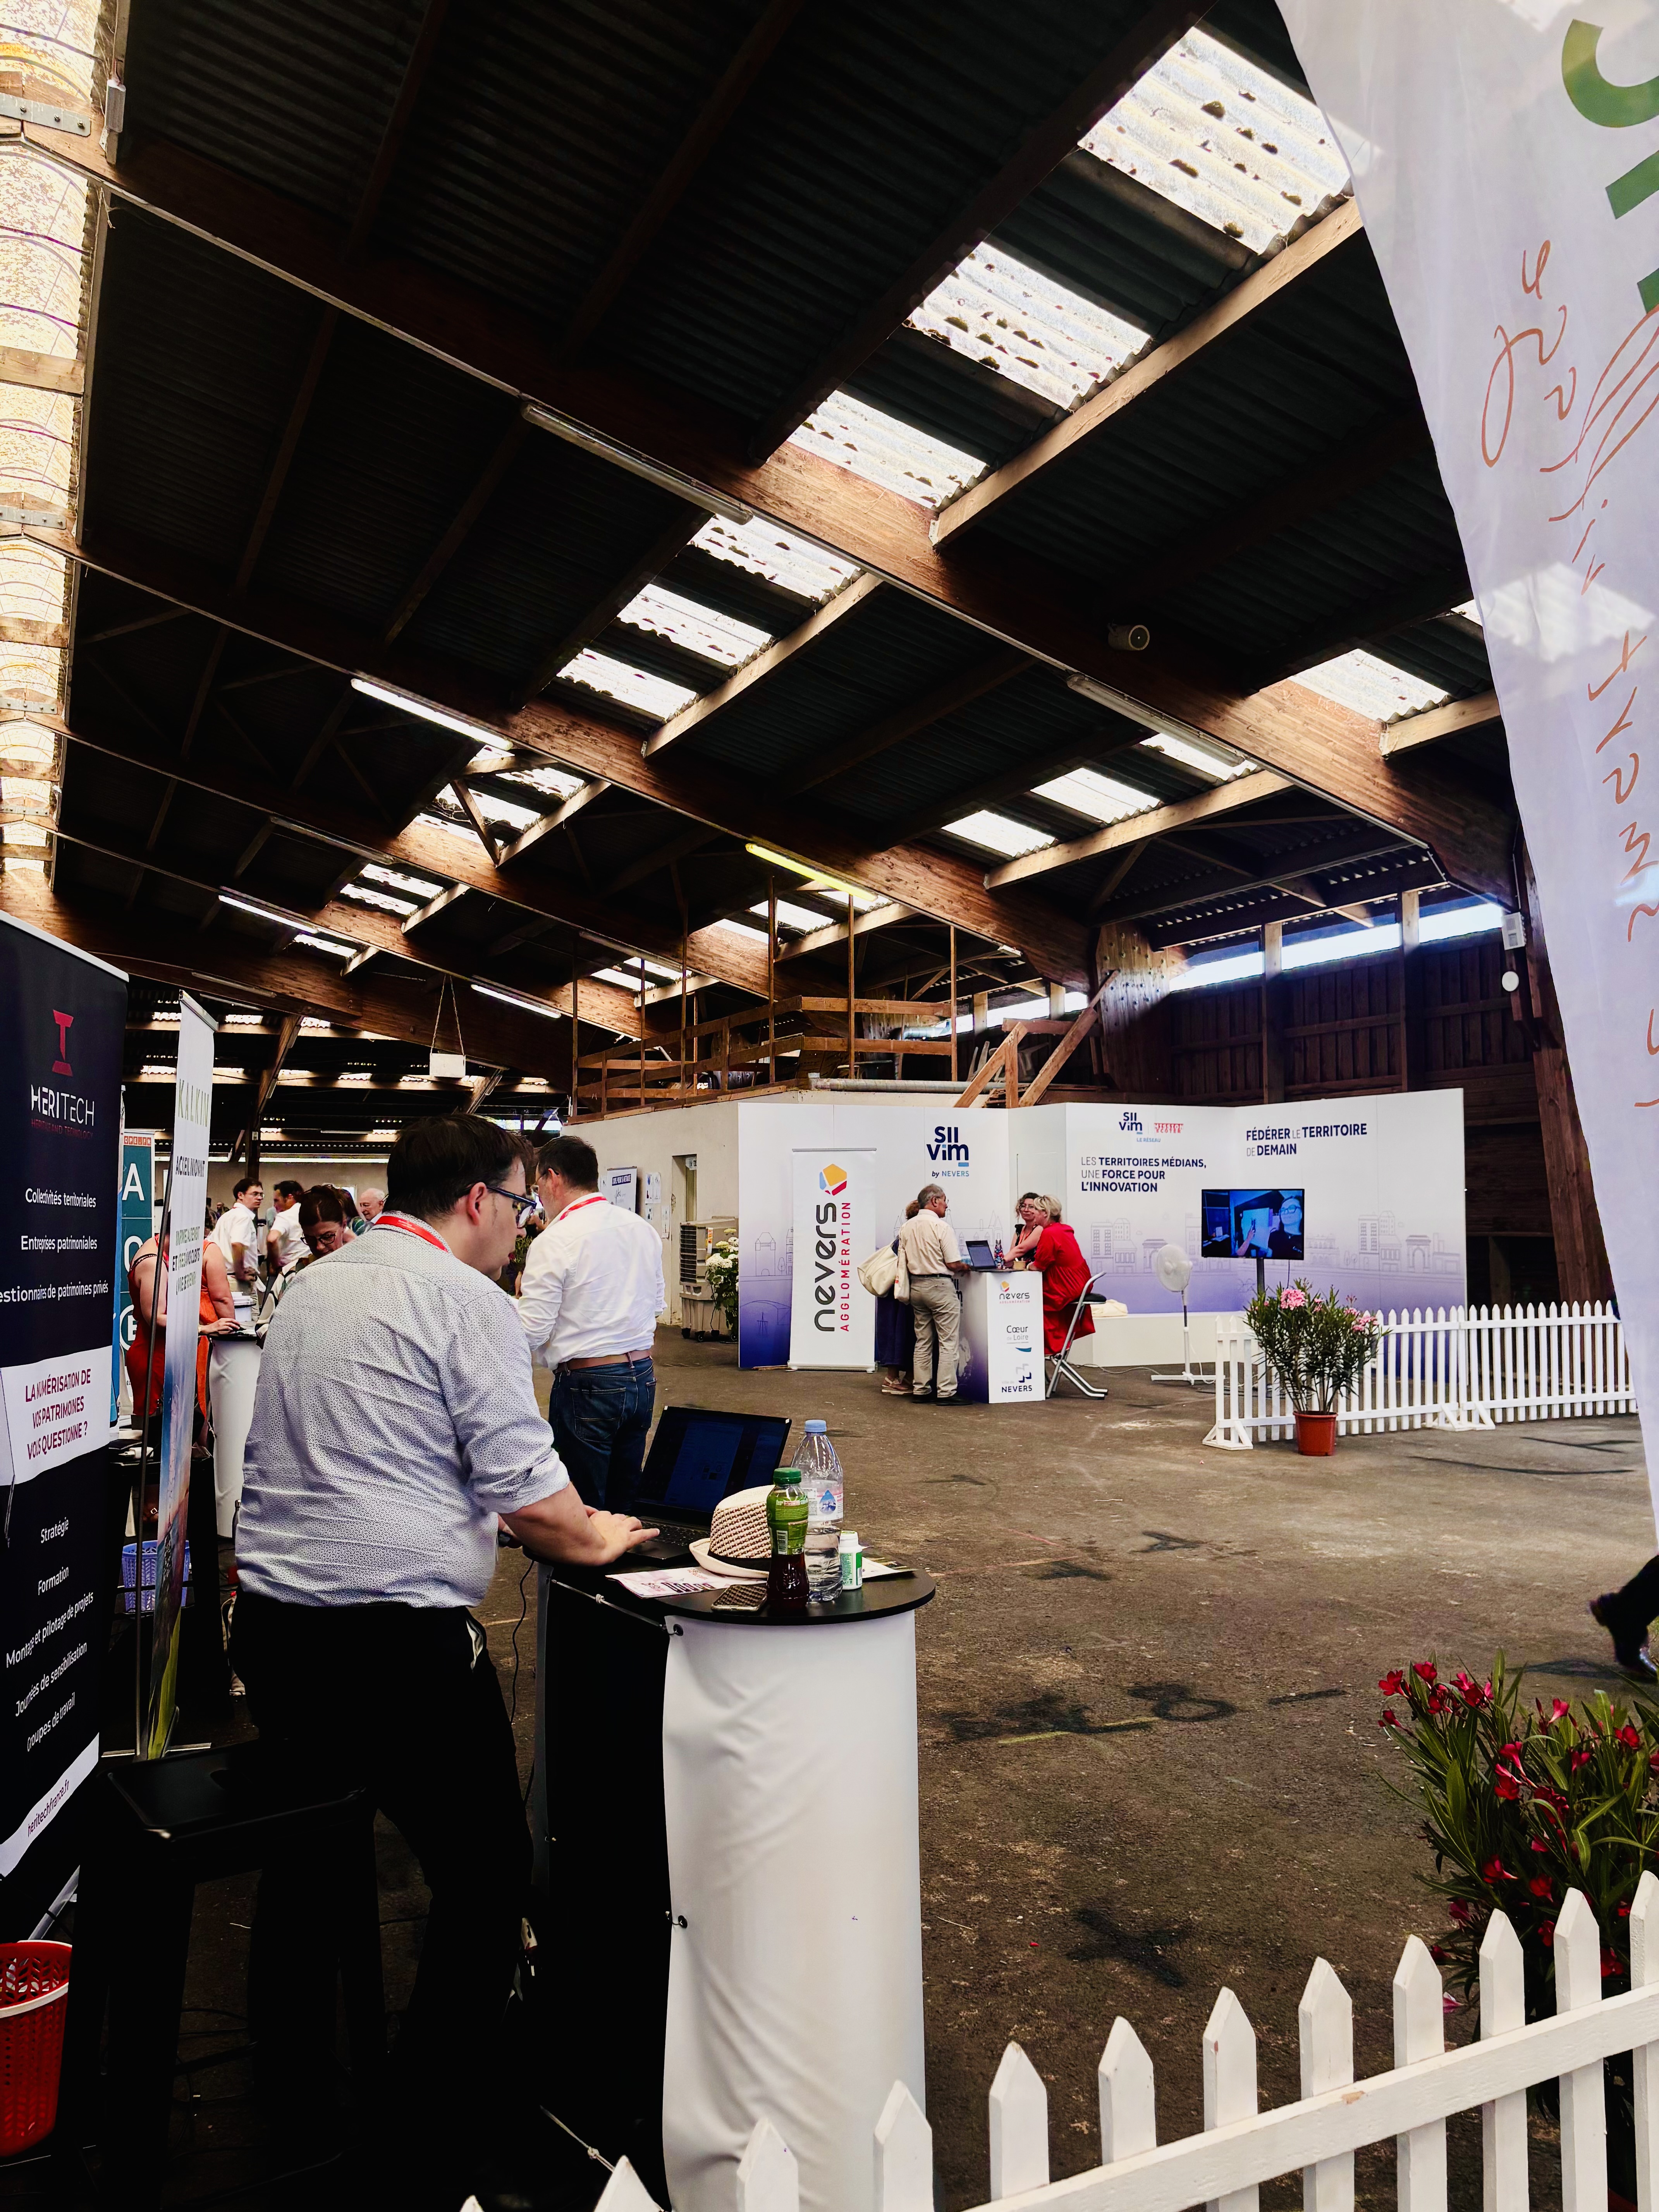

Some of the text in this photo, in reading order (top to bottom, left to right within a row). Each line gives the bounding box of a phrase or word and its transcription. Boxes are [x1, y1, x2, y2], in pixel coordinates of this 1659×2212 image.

[31, 1084, 94, 1126] HERITECH
[178, 1079, 209, 1127] KALKIN
[934, 1126, 958, 1143] SII
[1246, 1123, 1367, 1141] FÉDÉRER LE TERRITOIRE
[1246, 1143, 1297, 1156] DE DEMAIN
[1081, 1156, 1207, 1169] LES TERRITOIRES MÉDIANS,
[1081, 1170, 1165, 1179] UNE FORCE POUR
[25, 1188, 96, 1208] Collectivités territoriales
[1081, 1182, 1157, 1192] L'INNOVATION
[21, 1235, 97, 1254] Entreprises patrimoniales
[172, 1255, 178, 1271] ET
[814, 1202, 837, 1332] nevers
[838, 1203, 851, 1332] AGGLOMÉRATION
[48, 1284, 56, 1298] de
[58, 1281, 92, 1301] patrimoines
[93, 1279, 108, 1297] privés
[26, 1384, 36, 1402] LA
[81, 1369, 91, 1385] DE
[33, 1396, 84, 1429] VOS PATRIMOINES
[42, 1422, 82, 1455] QUESTIONNE
[41, 1516, 69, 1544] Stratégie
[38, 1566, 69, 1595] Formation
[34, 1629, 41, 1645] et
[42, 1612, 67, 1643] pilotage
[67, 1604, 74, 1620] de
[74, 1592, 94, 1618] projets
[40, 1674, 49, 1690] de
[52, 1711, 59, 1728] de
[60, 1692, 75, 1719] travail
